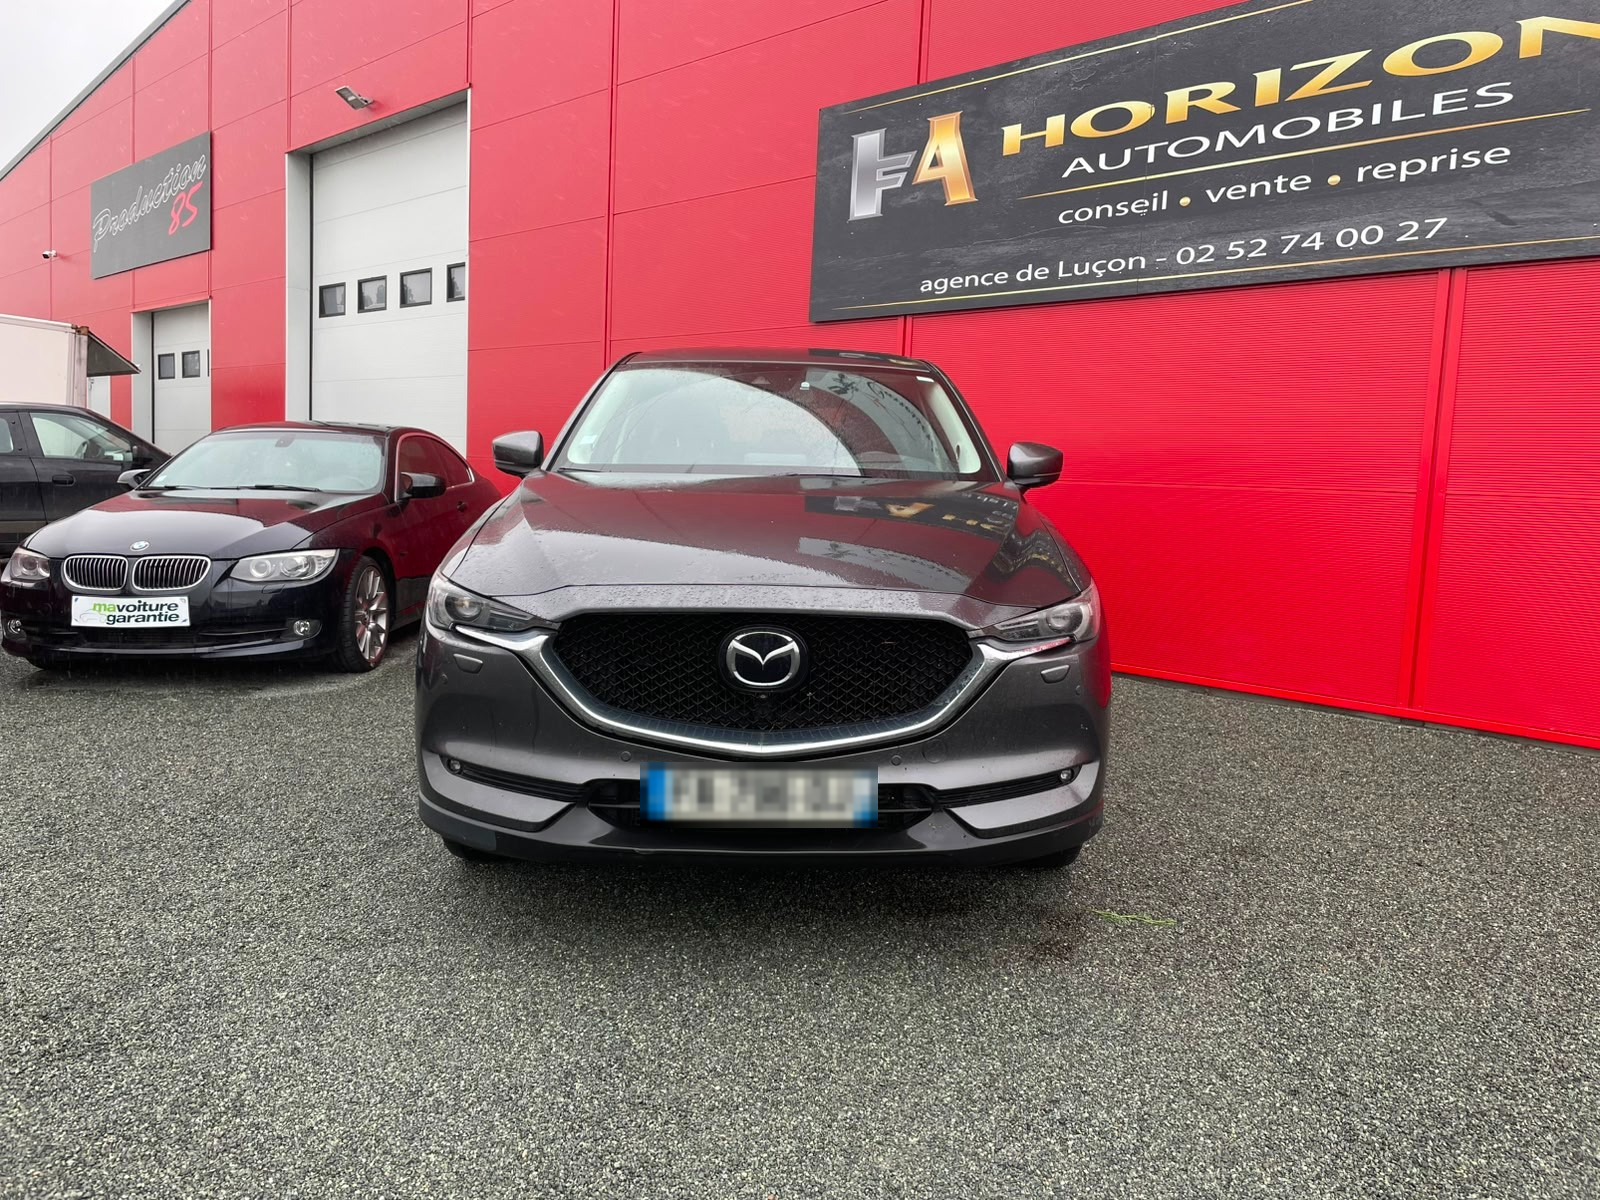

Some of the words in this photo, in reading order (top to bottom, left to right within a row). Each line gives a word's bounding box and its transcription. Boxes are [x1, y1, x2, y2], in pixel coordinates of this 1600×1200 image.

[1001, 16, 1600, 156] HORIZON
[1062, 82, 1513, 178] AUTOMOBILES
[92, 154, 206, 253] Production
[168, 181, 203, 235] 85
[1059, 190, 1168, 224] conseil
[1206, 174, 1311, 203] vente
[1357, 147, 1511, 182] reprise
[920, 271, 1008, 294] agence
[1016, 264, 1049, 282] de
[1058, 255, 1146, 278] Luçon
[1176, 245, 1215, 265] 02
[1226, 239, 1267, 260] 52
[1280, 232, 1325, 254] 74
[1336, 225, 1384, 248] 00
[1396, 217, 1448, 242] 27
[92, 600, 179, 612] mavoiture
[106, 612, 180, 625] garantie
